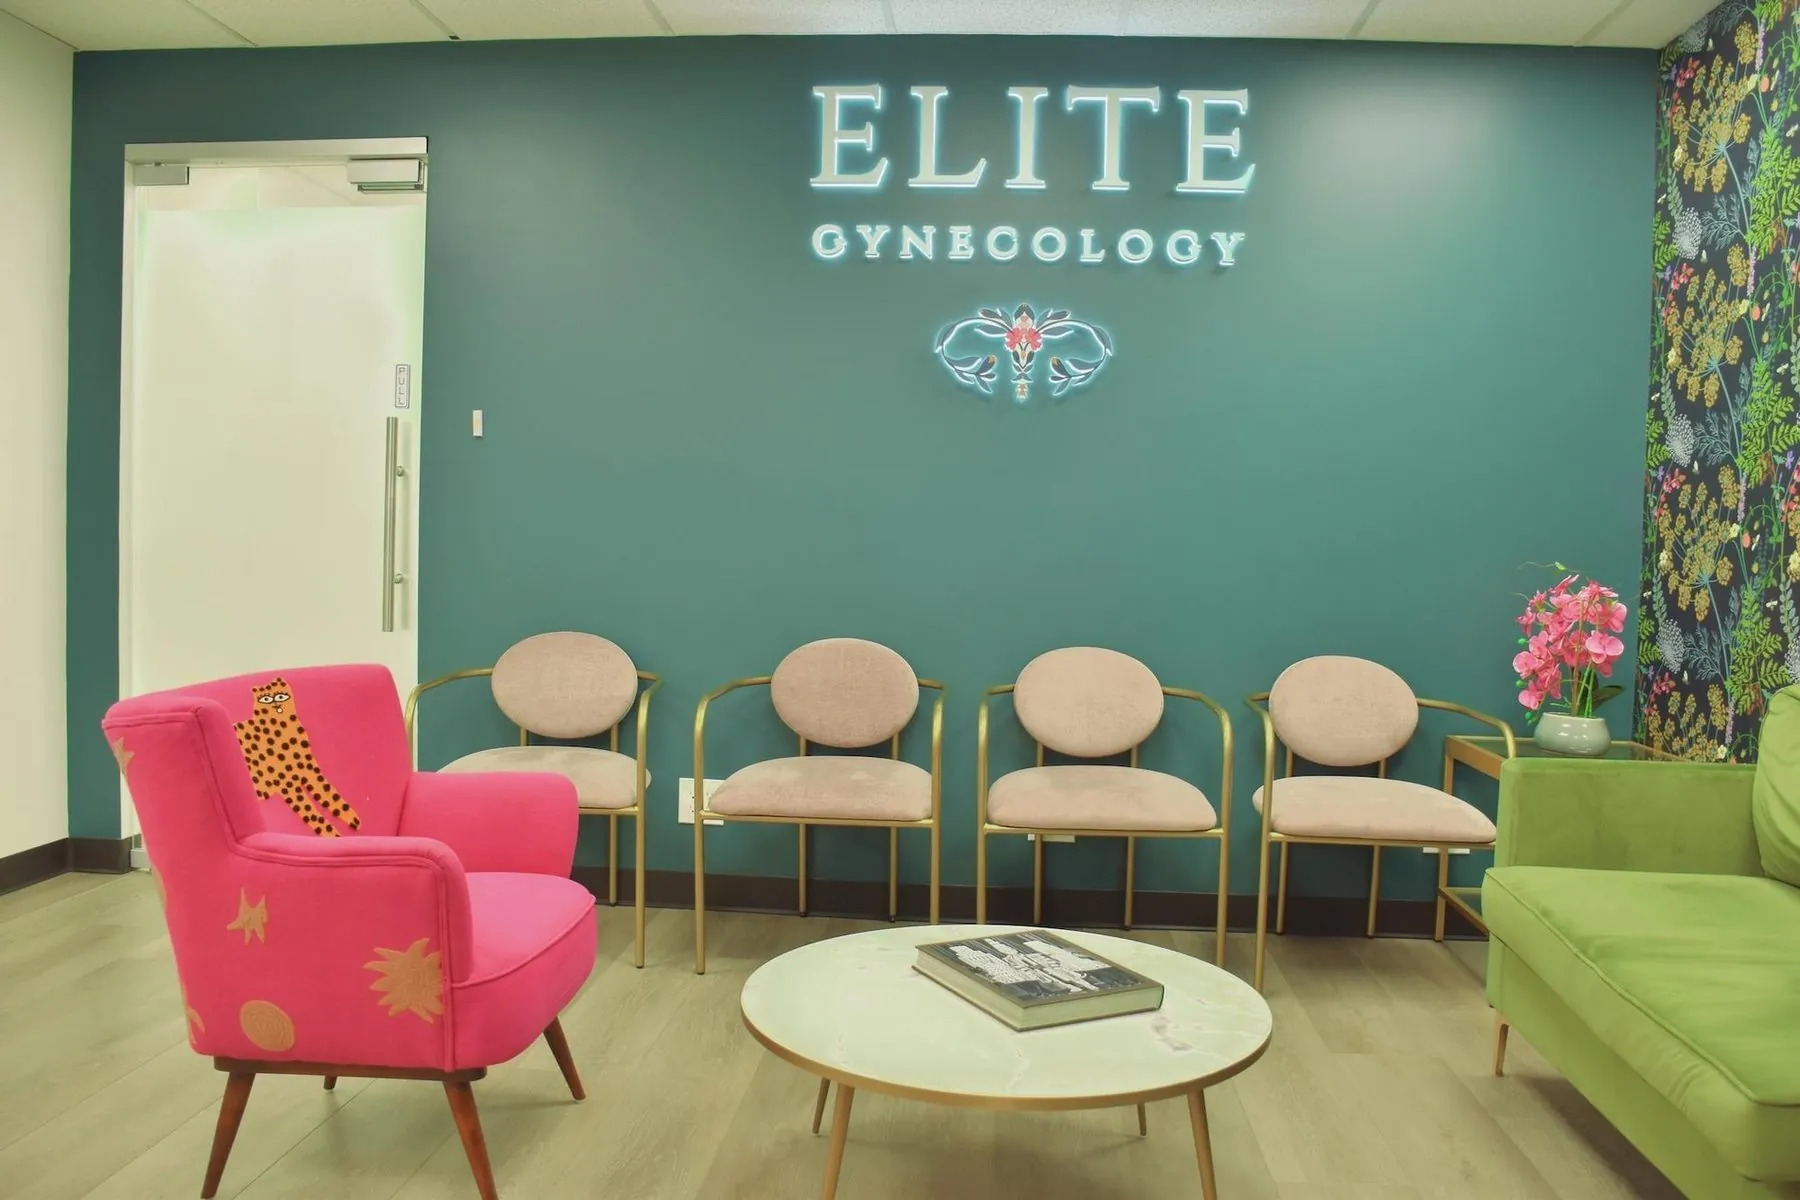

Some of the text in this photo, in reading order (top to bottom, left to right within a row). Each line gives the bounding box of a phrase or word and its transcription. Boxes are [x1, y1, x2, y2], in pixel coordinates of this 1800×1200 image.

[810, 83, 1256, 193] ELITE
[811, 224, 1246, 266] GYNECOLOGY
[398, 366, 406, 406] PULL
